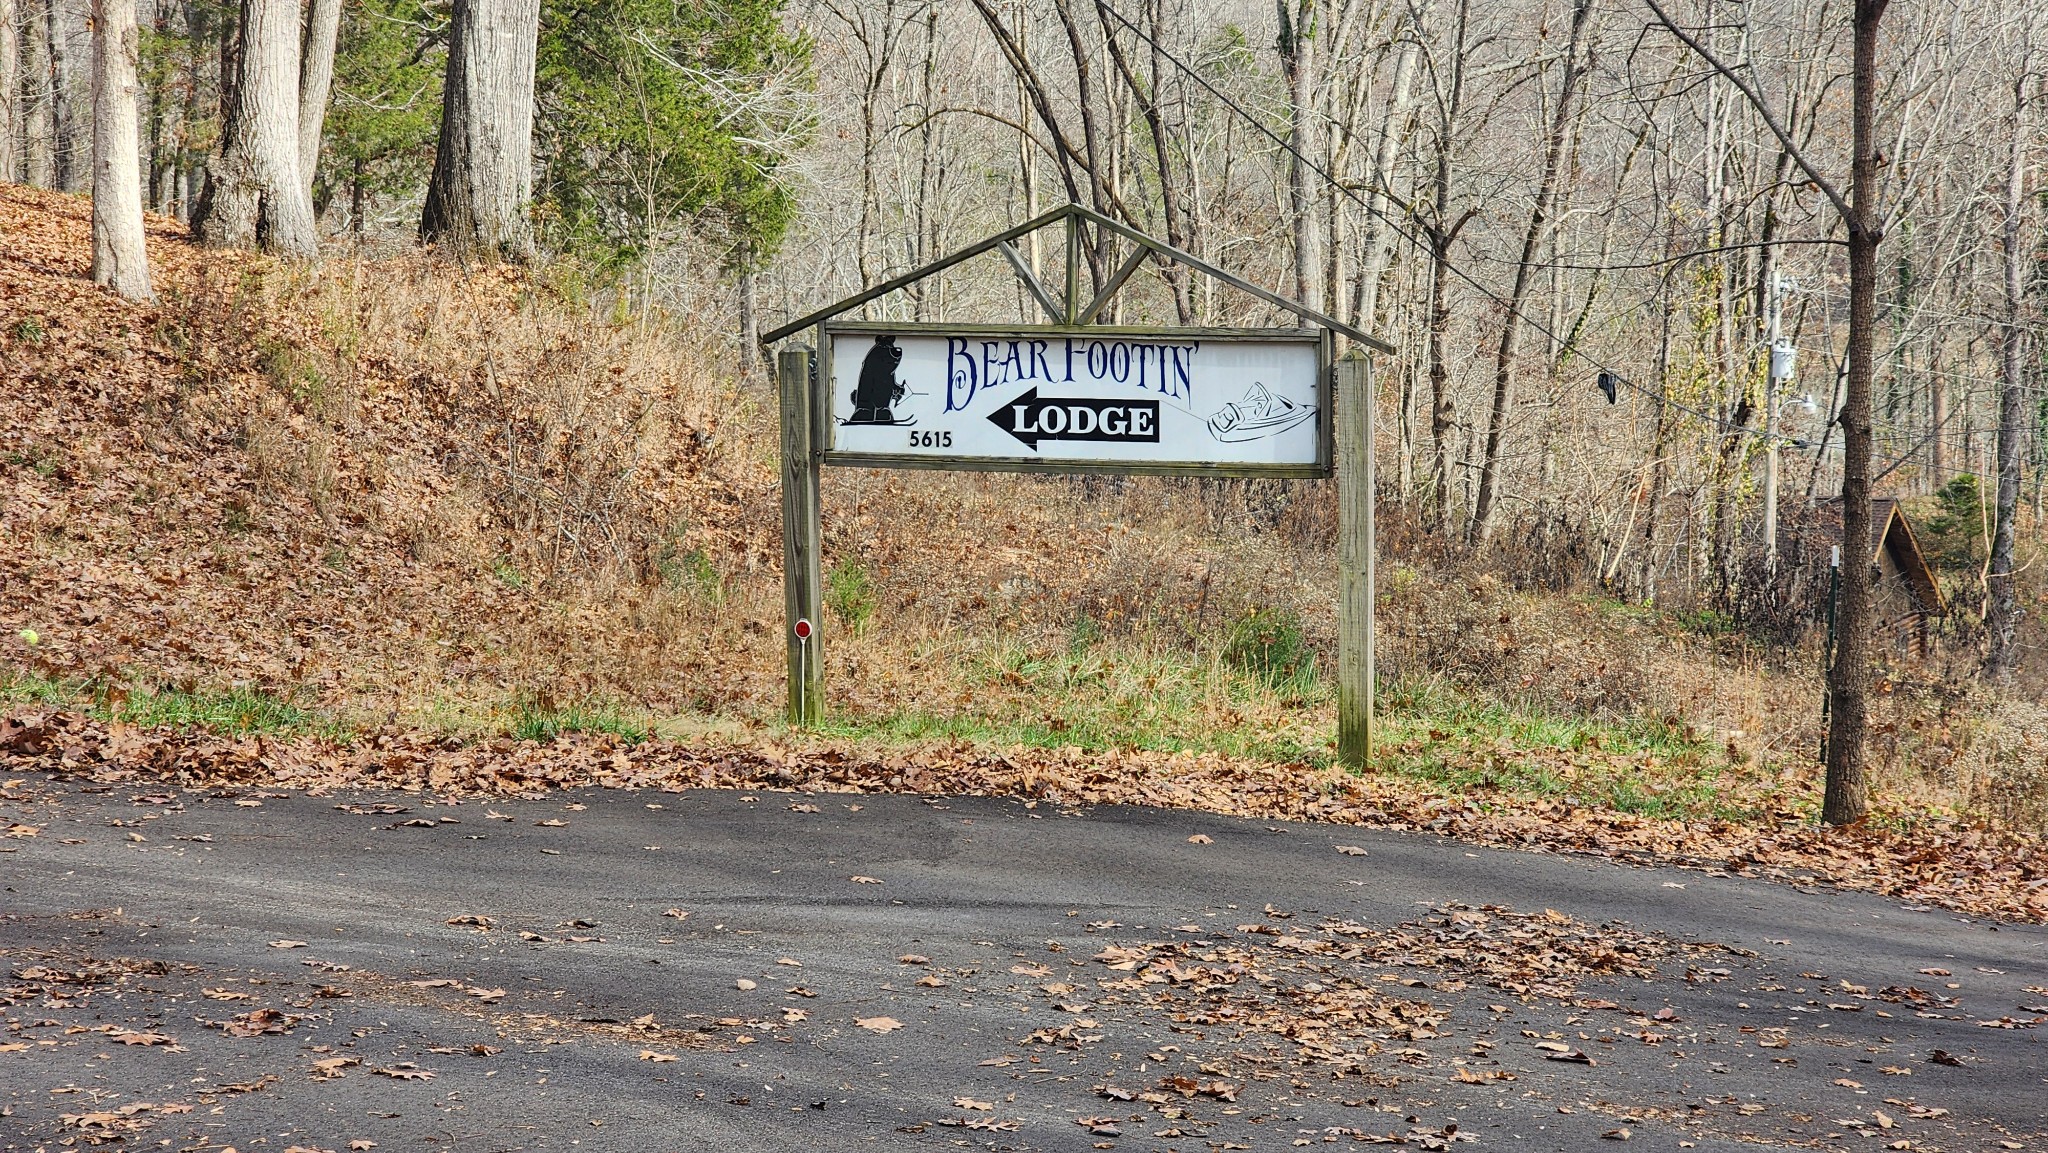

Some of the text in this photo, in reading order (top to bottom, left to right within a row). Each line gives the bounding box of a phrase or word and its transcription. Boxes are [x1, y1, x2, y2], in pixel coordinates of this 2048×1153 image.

[943, 336, 1059, 414] BEAR
[1012, 404, 1154, 436] LODGE
[909, 430, 952, 448] 5615
